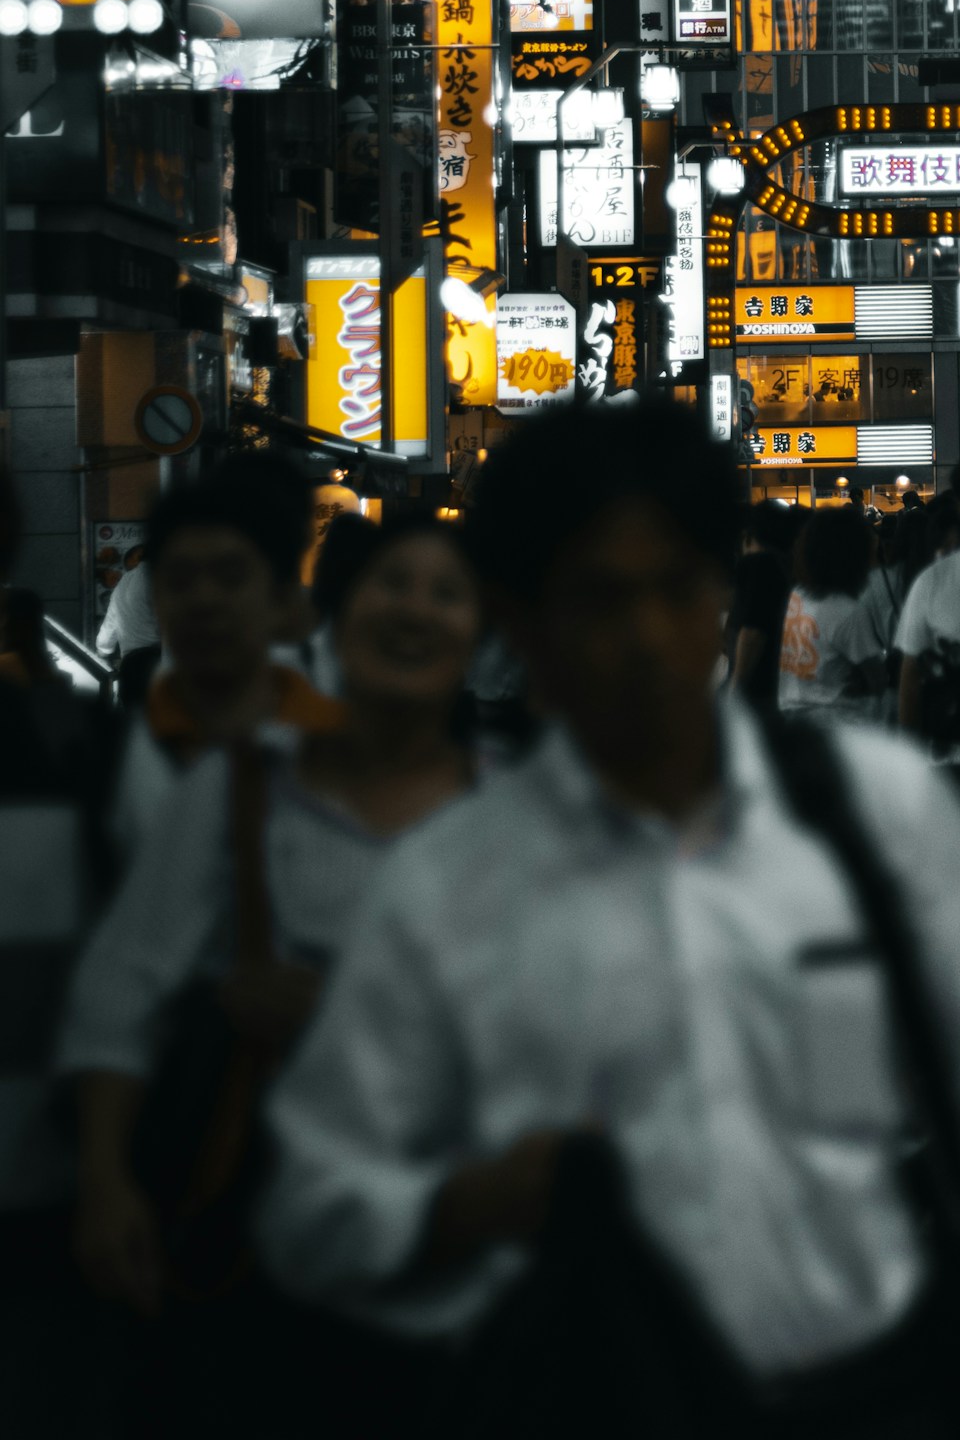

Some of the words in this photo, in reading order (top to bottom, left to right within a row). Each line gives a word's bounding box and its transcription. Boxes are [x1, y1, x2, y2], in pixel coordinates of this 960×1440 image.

[681, 21, 726, 35] 銀行ATM
[602, 228, 632, 243] B1F
[743, 323, 816, 335] YOSHINOYA
[506, 354, 568, 383] 190円
[771, 369, 801, 392] 2F
[716, 380, 727, 437] 劇場通り
